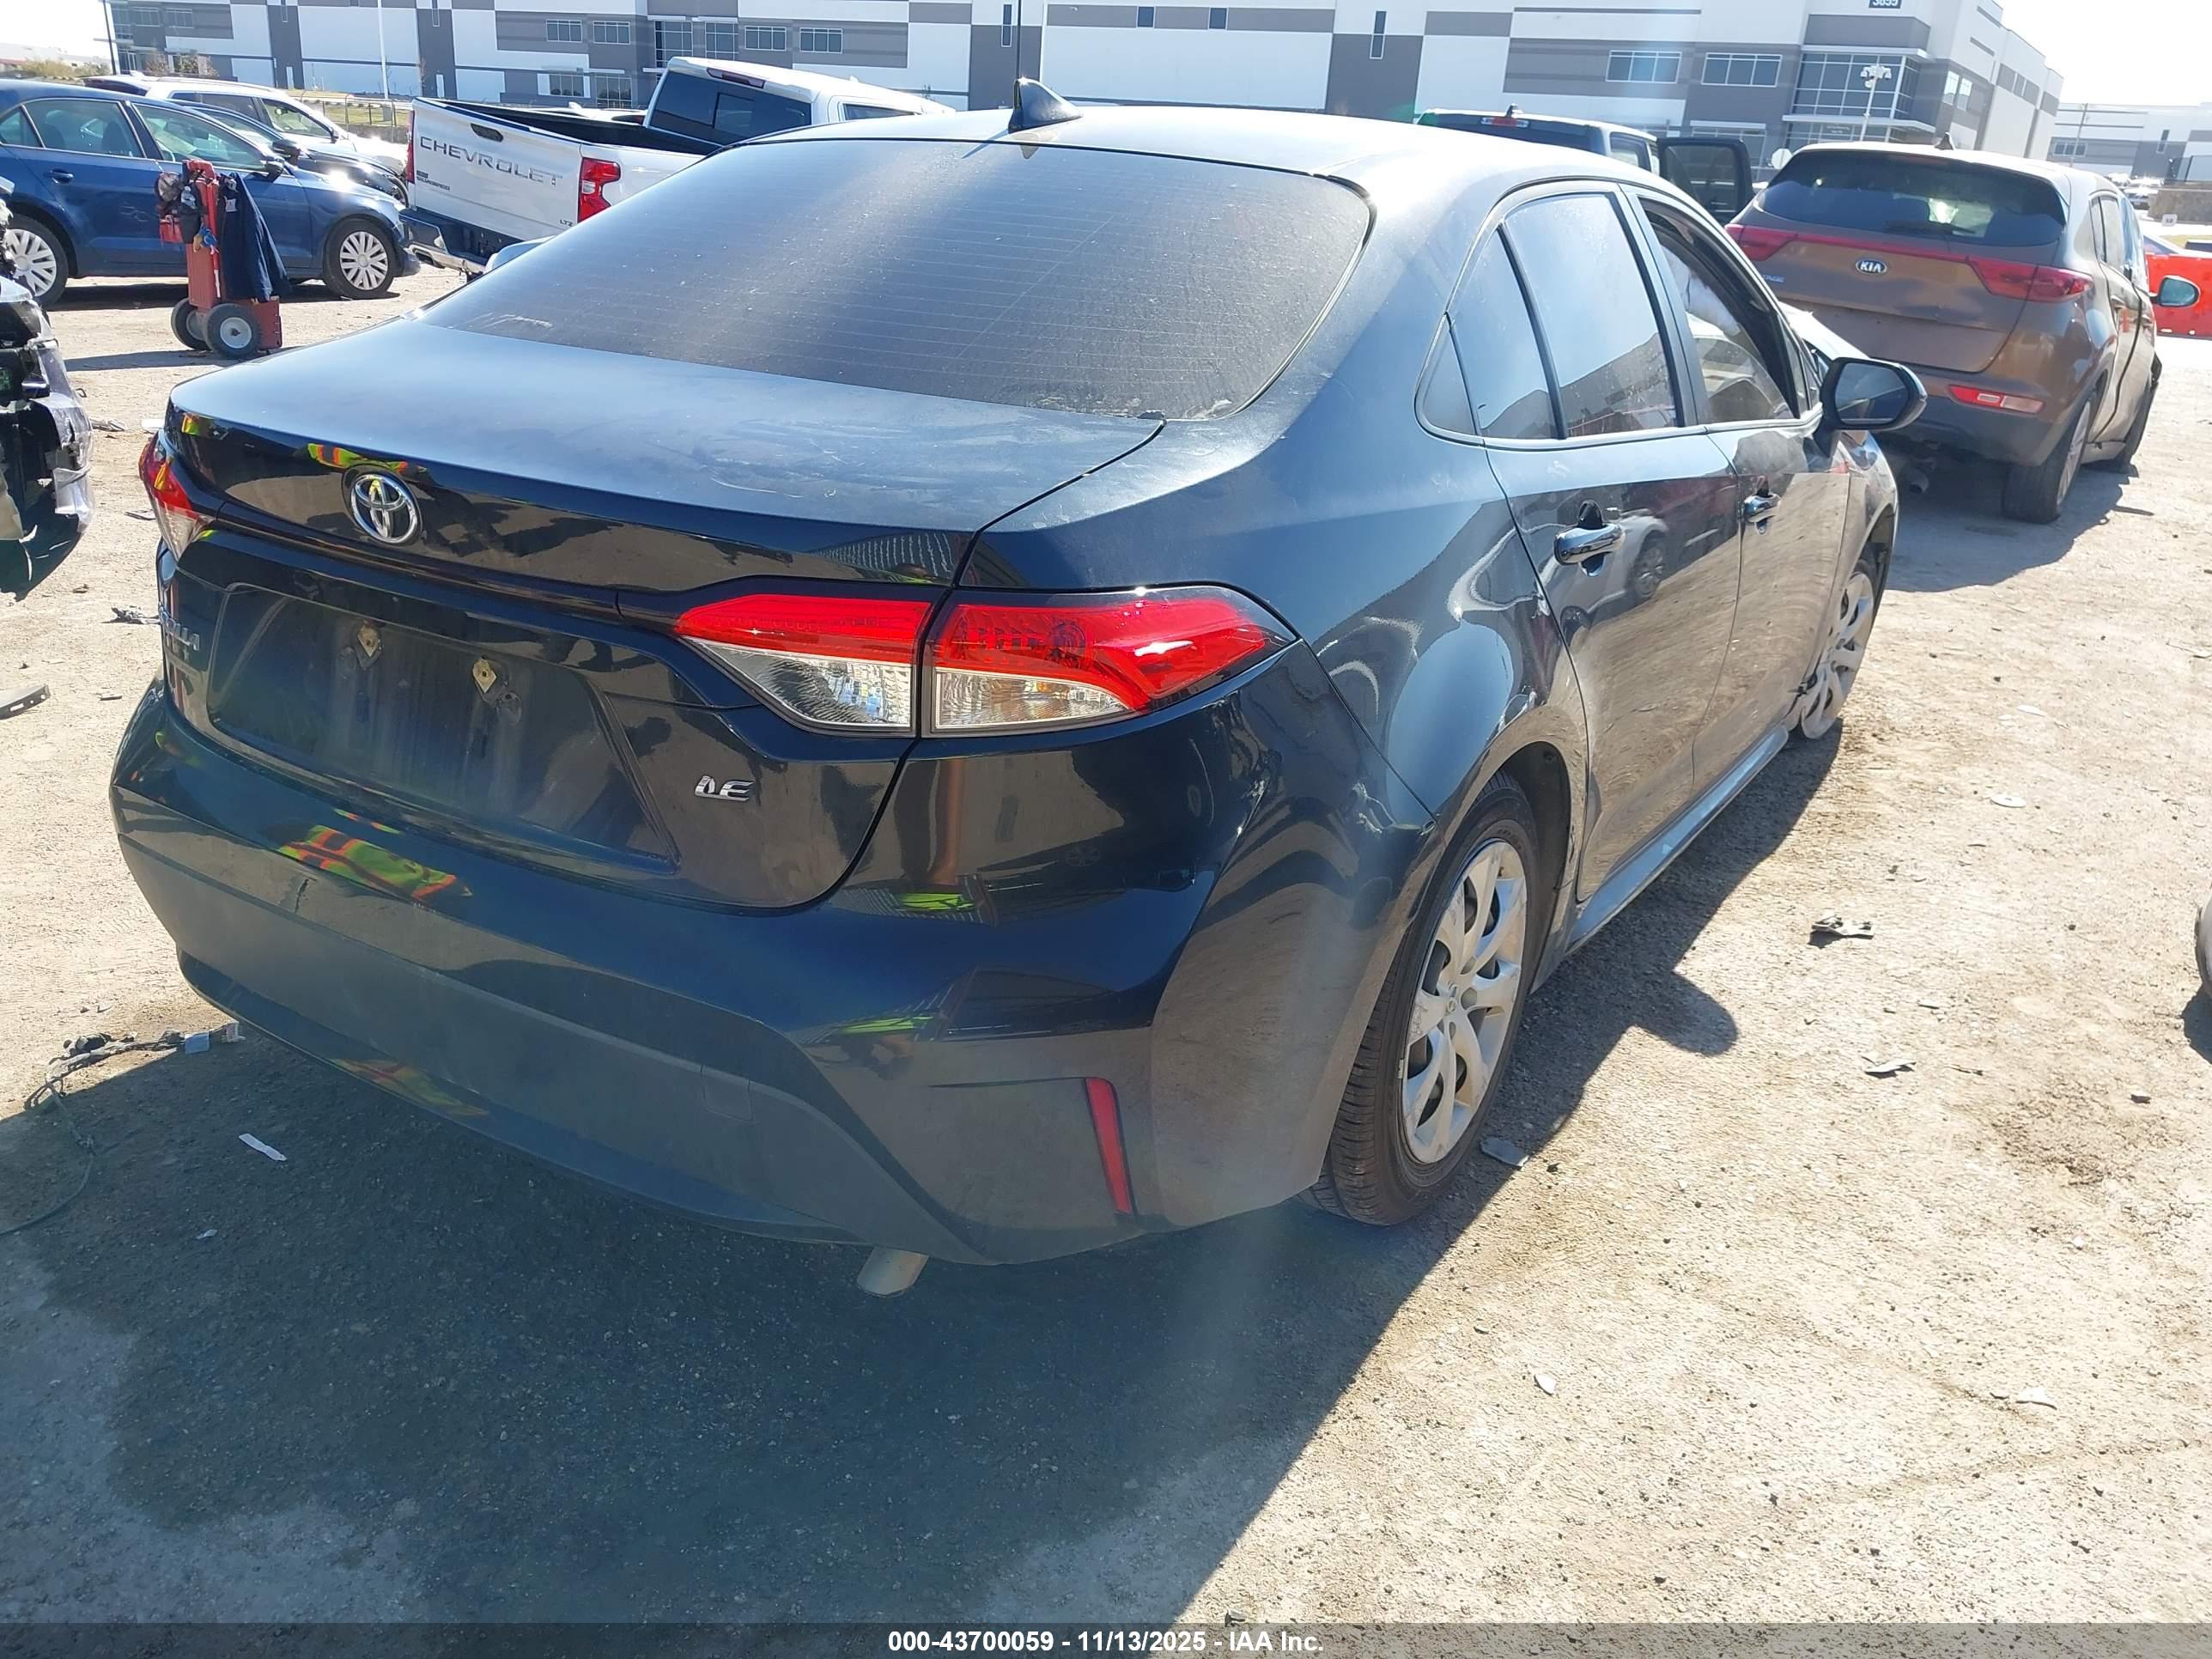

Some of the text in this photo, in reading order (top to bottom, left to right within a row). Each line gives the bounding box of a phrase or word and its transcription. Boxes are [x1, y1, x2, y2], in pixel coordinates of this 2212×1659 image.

[420, 136, 563, 185] CHEVROLET
[1860, 260, 1881, 273] KIA
[695, 775, 755, 802] LE
